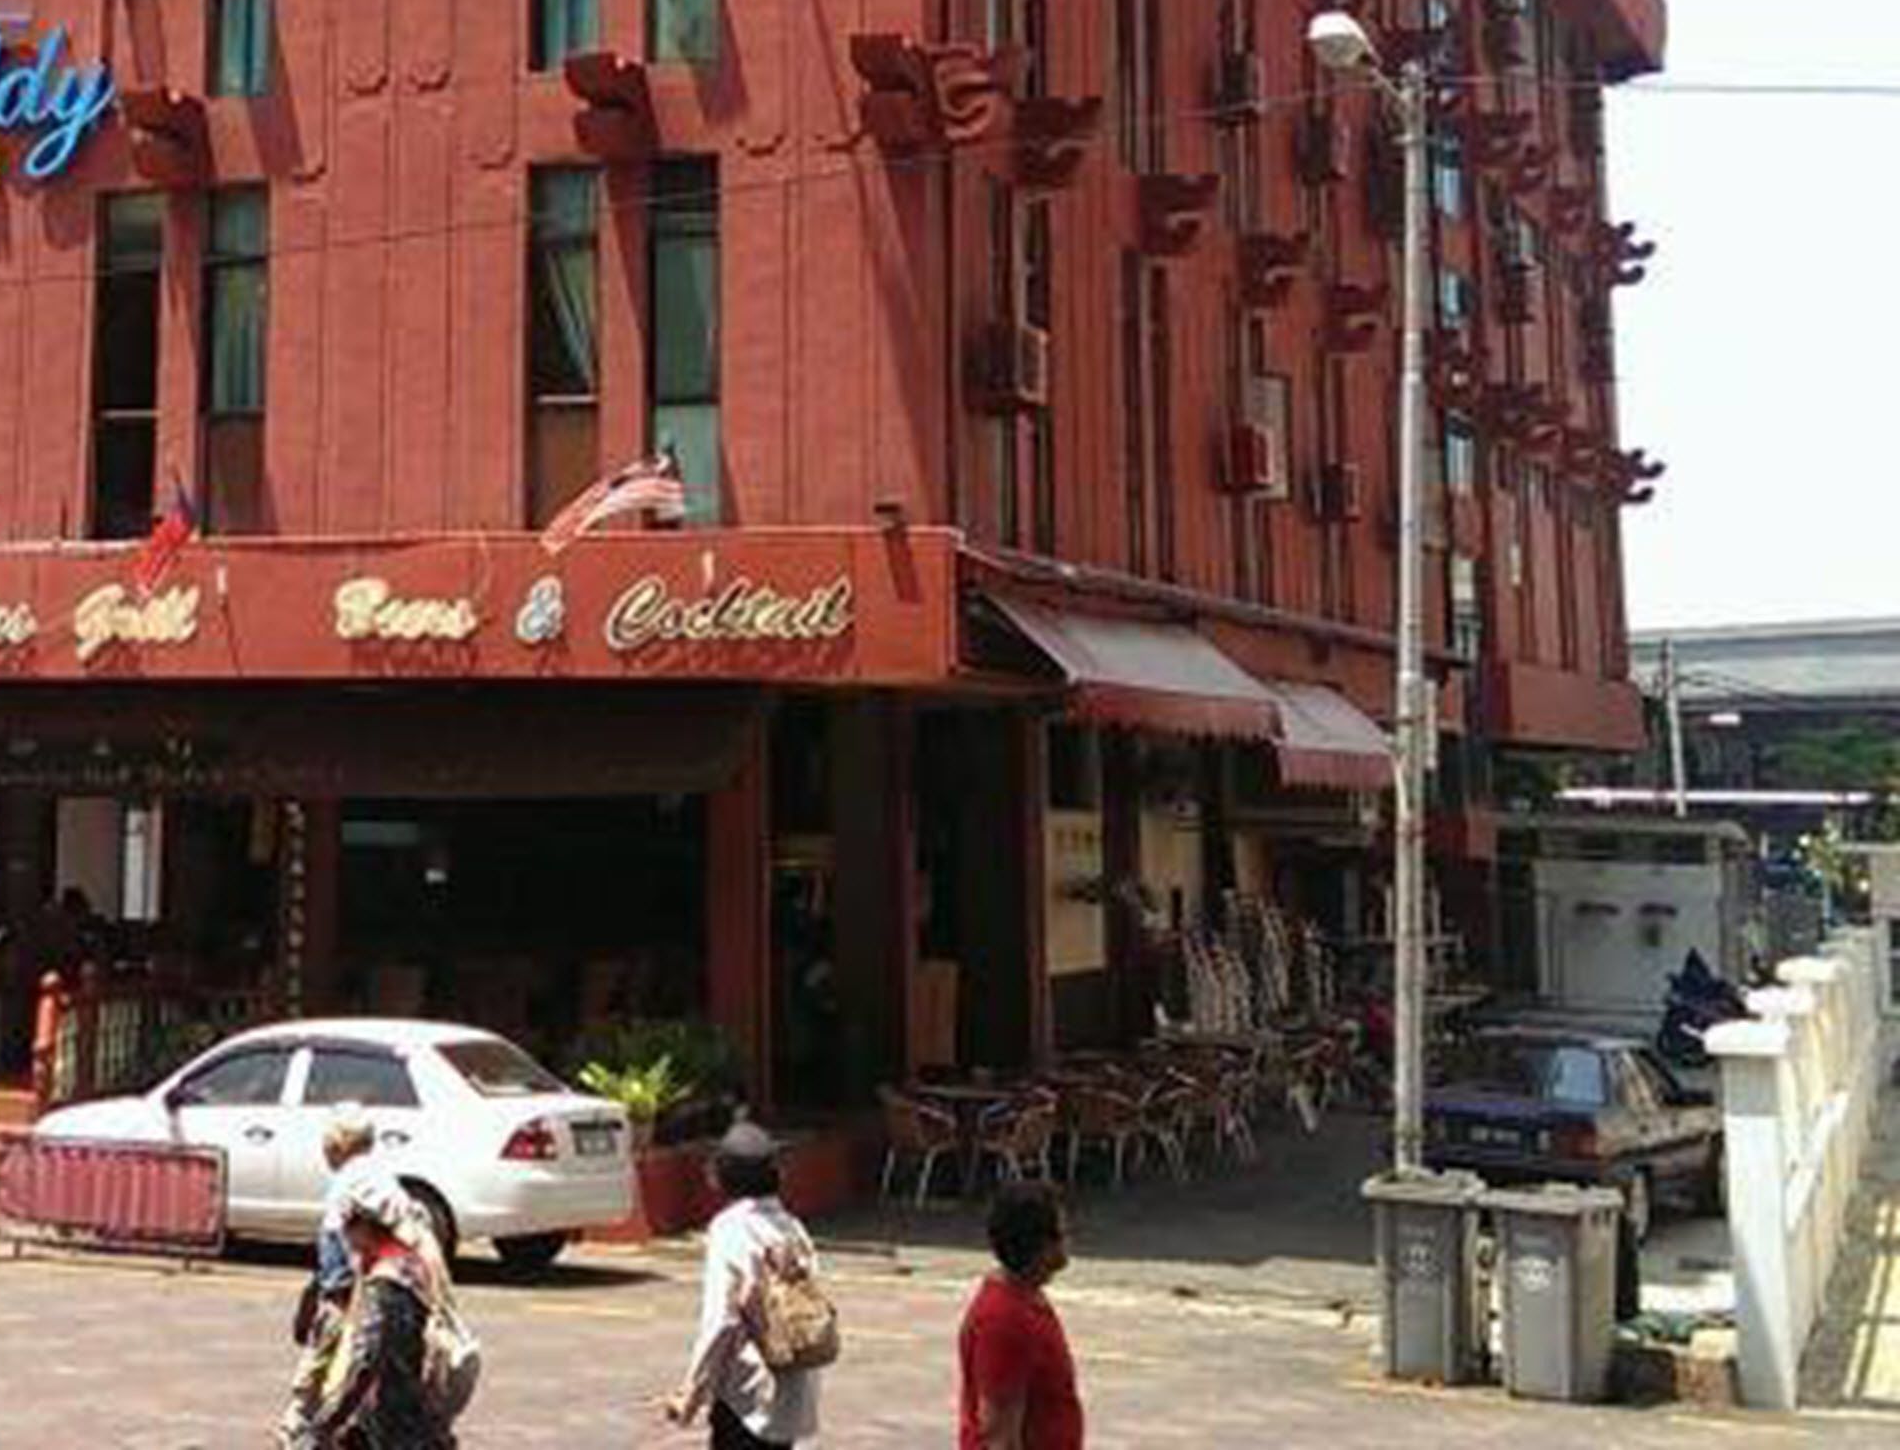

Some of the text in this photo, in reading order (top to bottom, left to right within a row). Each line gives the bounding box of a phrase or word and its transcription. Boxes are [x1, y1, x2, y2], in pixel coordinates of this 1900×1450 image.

[74, 582, 200, 660] Grill
[514, 574, 564, 646] &
[604, 572, 854, 650] Cocktail
